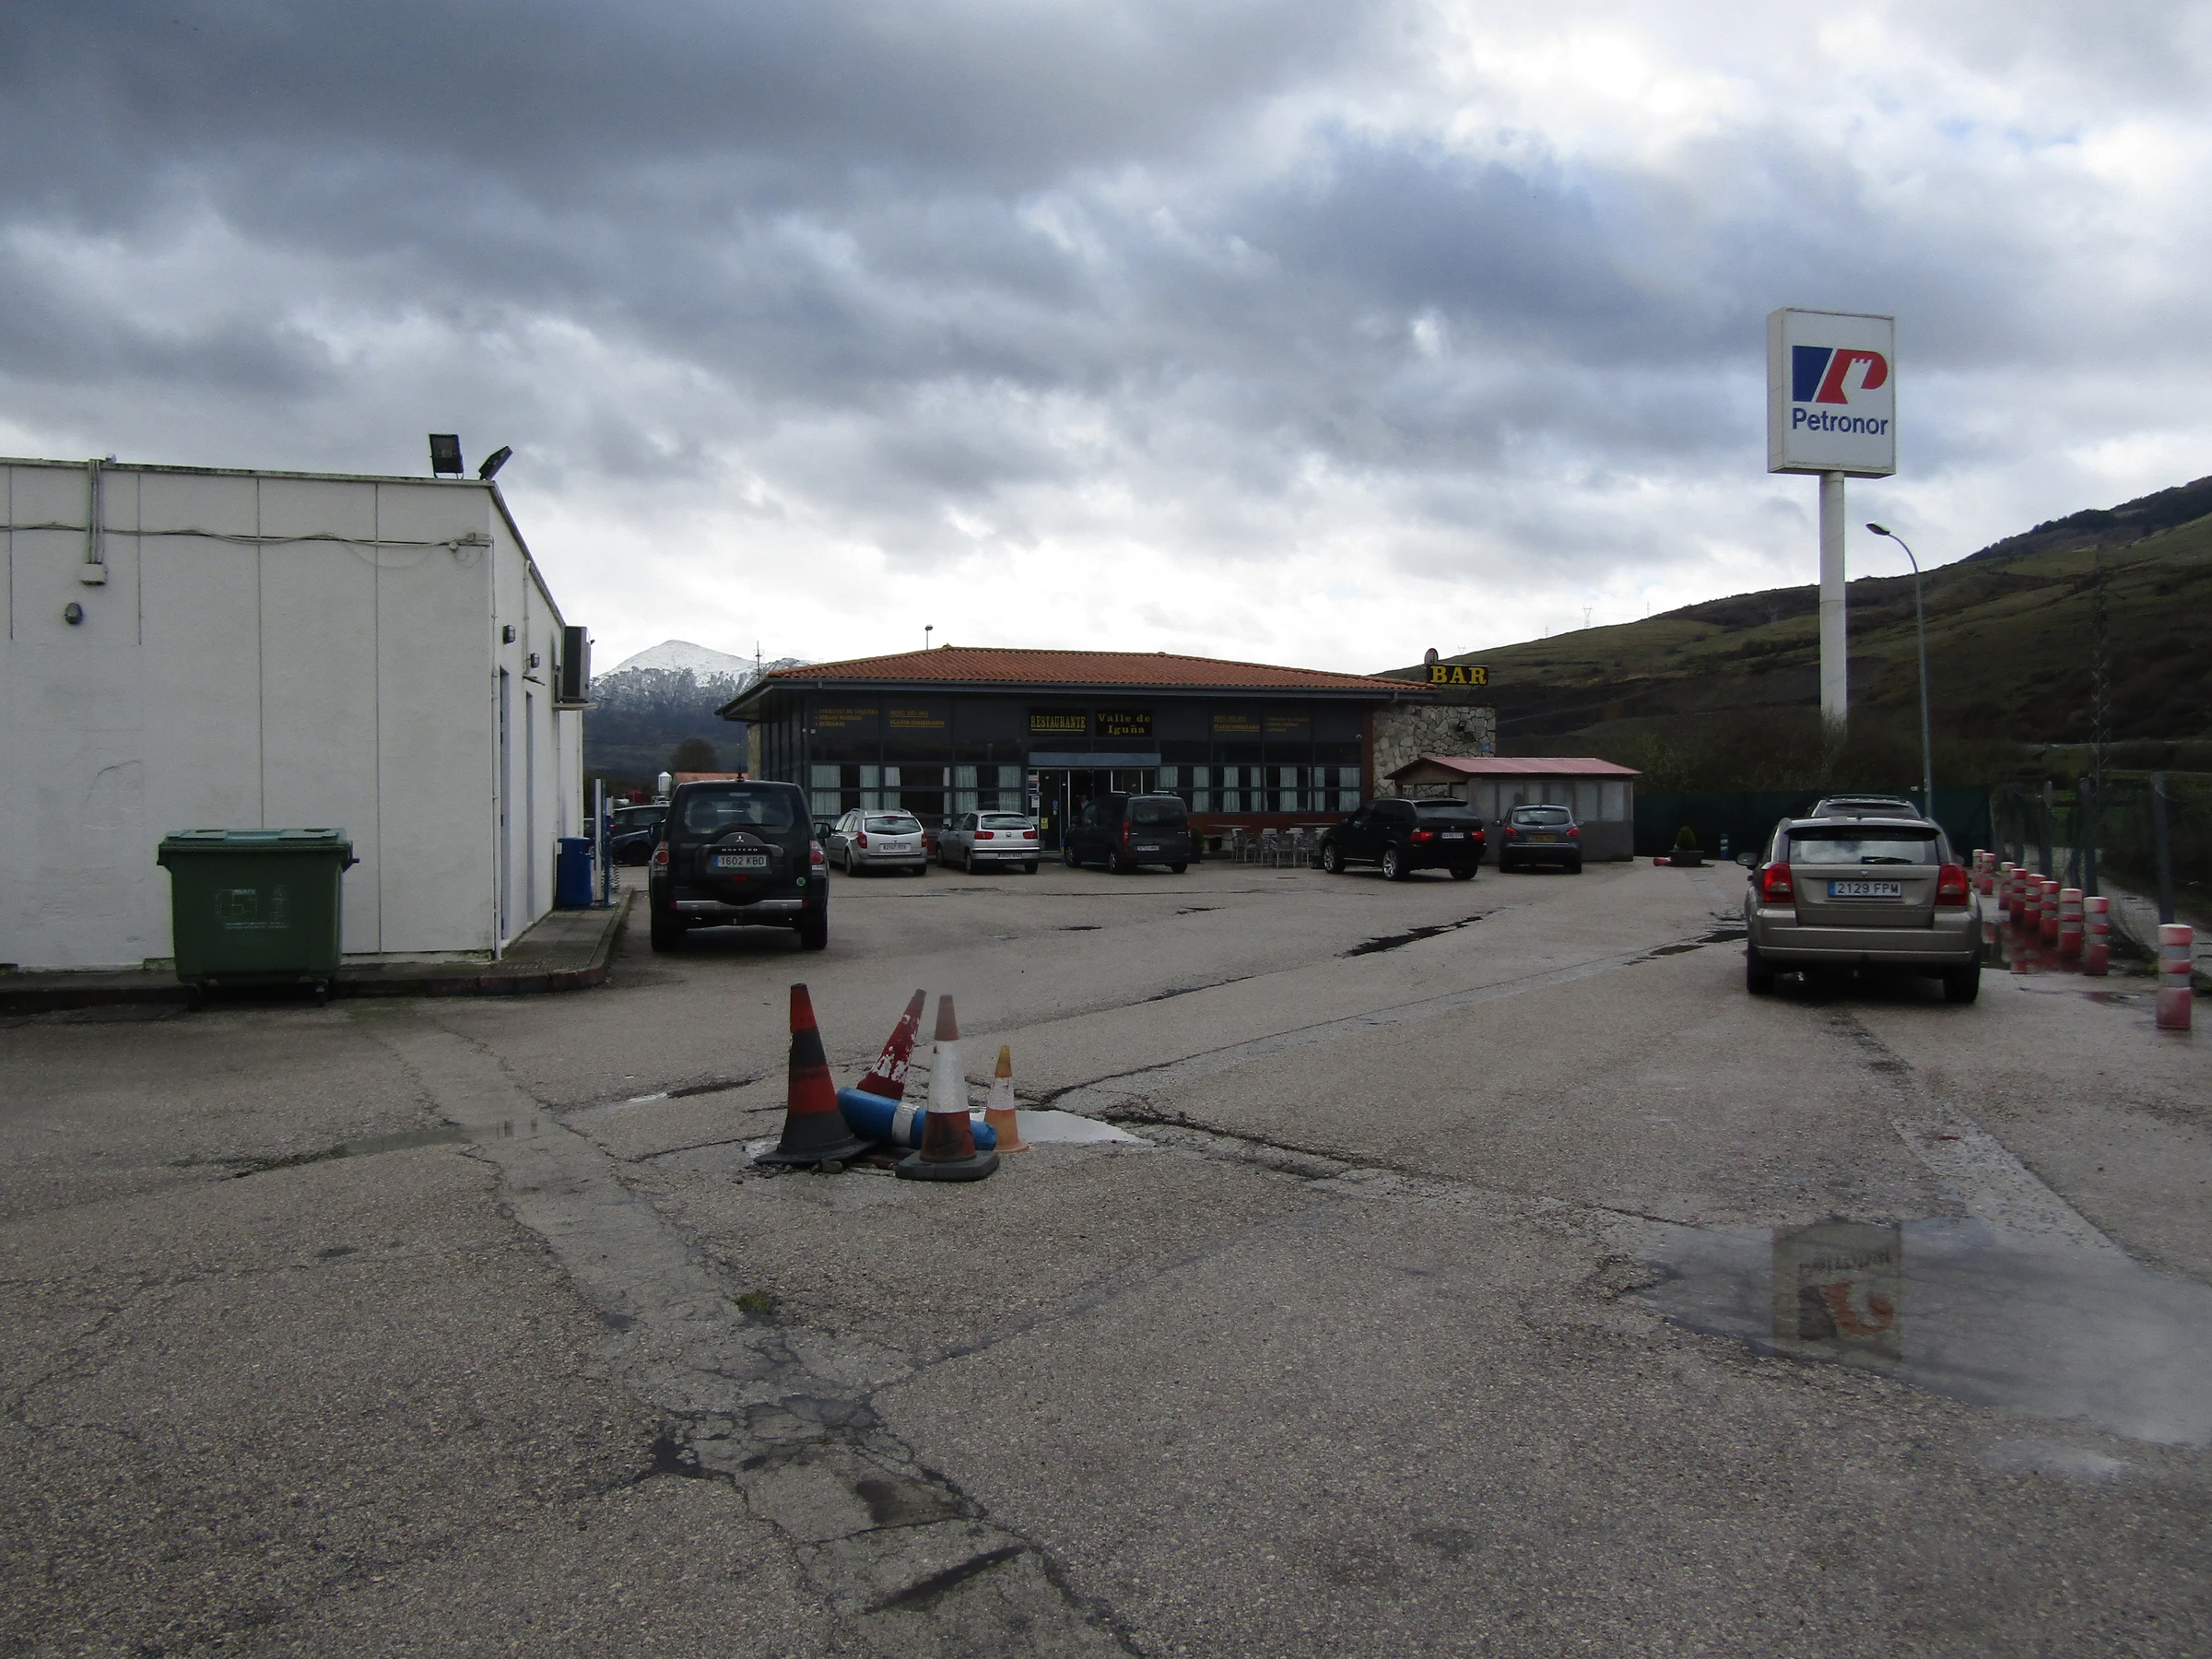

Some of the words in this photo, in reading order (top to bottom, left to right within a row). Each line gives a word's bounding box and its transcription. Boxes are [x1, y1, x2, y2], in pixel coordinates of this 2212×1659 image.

[1792, 407, 1888, 436] Petronor
[1430, 665, 1487, 685] BAR
[1030, 715, 1087, 728] RESTAURANTE
[1097, 713, 1132, 723] Valle
[1135, 713, 1151, 723] de
[1107, 724, 1146, 735] Iguña
[721, 856, 744, 865] 1602
[746, 856, 764, 865] KBD
[1837, 883, 1869, 894] 2129
[1874, 883, 1899, 894] FPM
